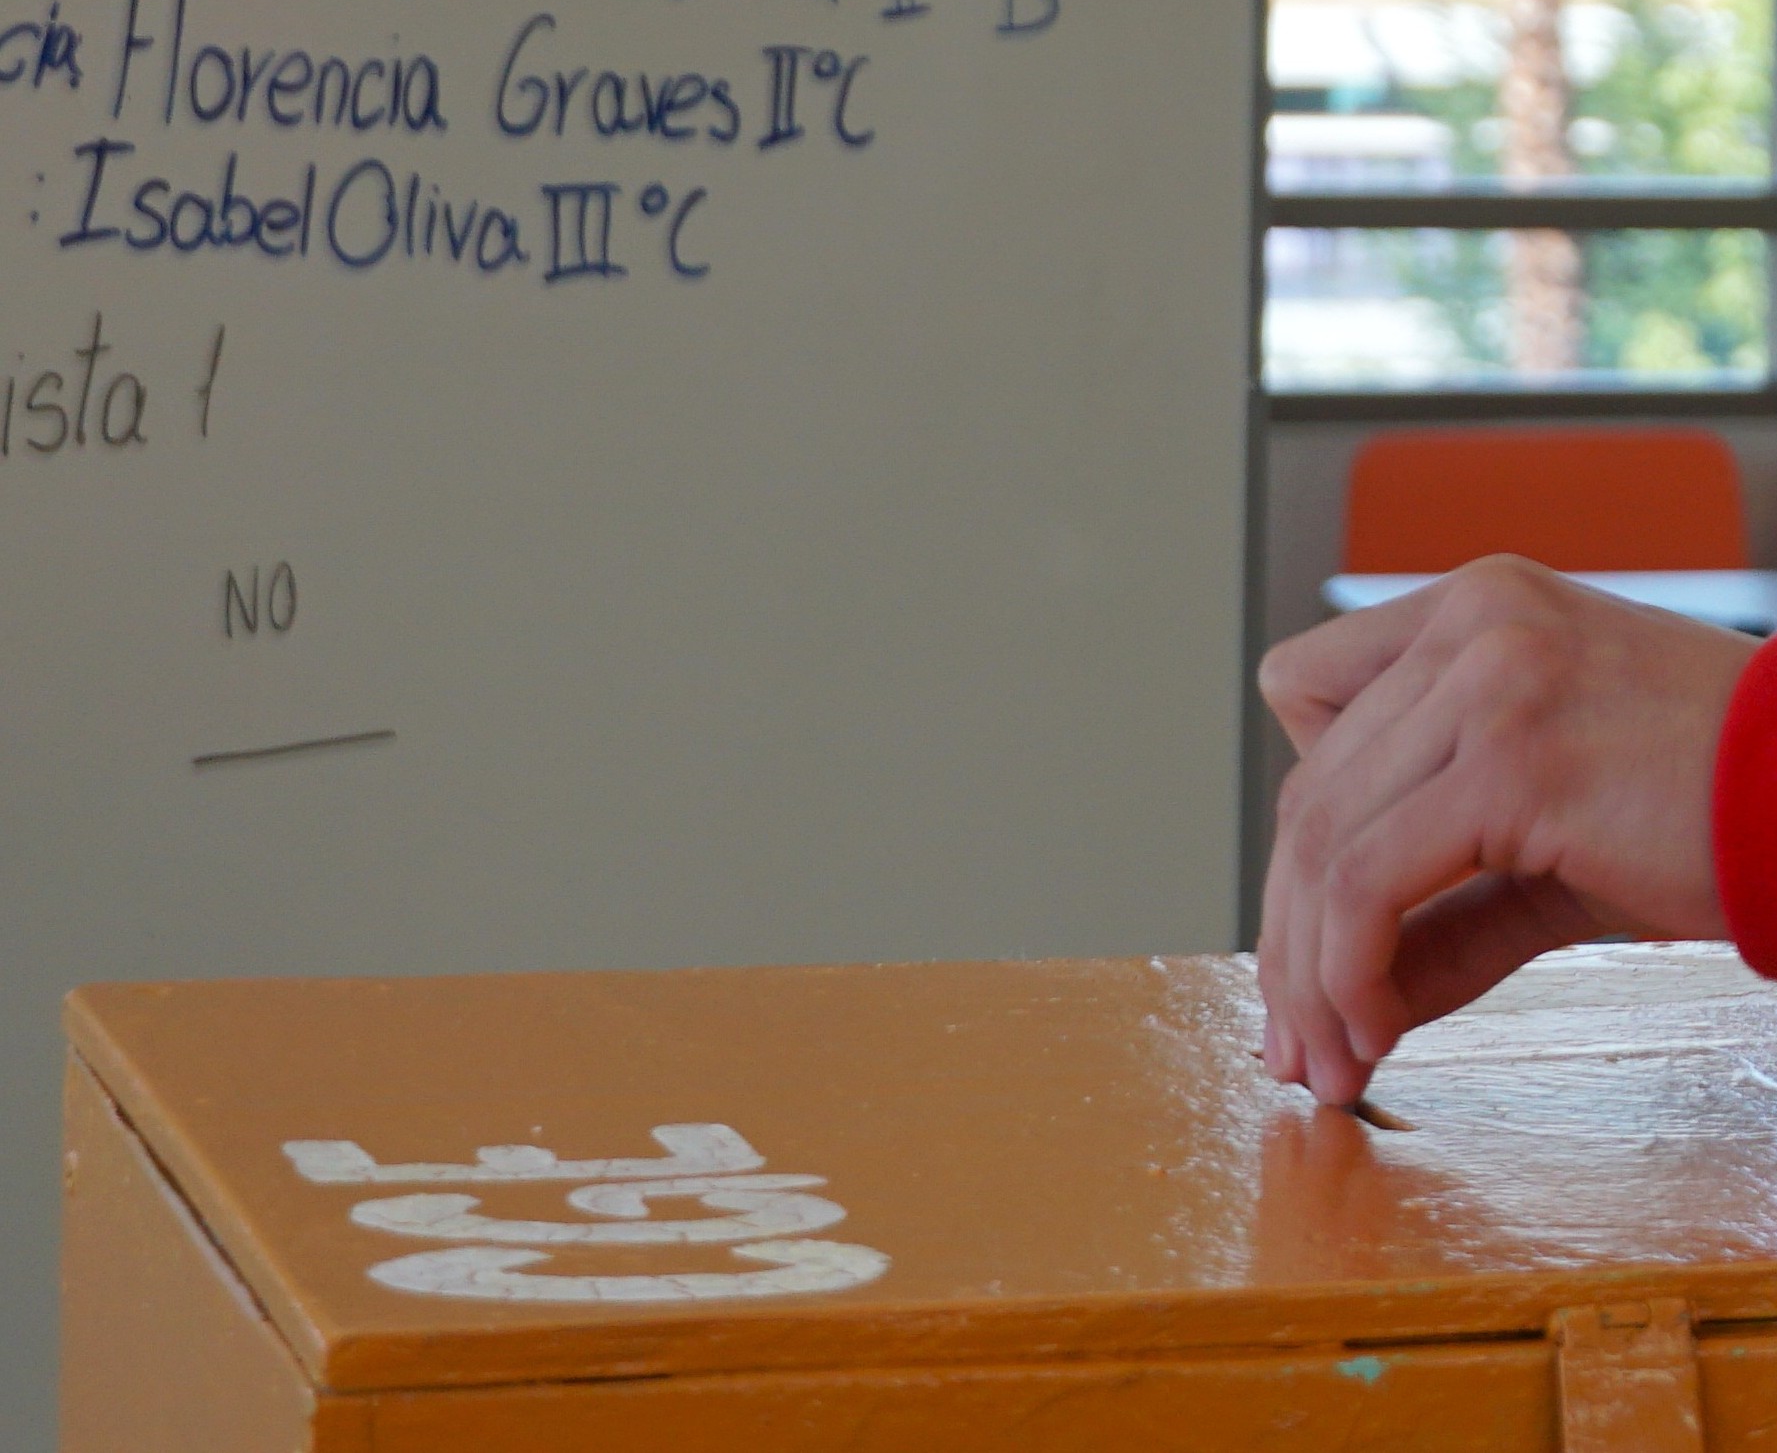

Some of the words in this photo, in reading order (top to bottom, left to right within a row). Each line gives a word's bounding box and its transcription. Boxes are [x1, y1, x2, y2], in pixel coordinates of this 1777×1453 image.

[495, 16, 739, 144] Graves
[329, 162, 527, 272] Oliva
[226, 564, 294, 636] NO
